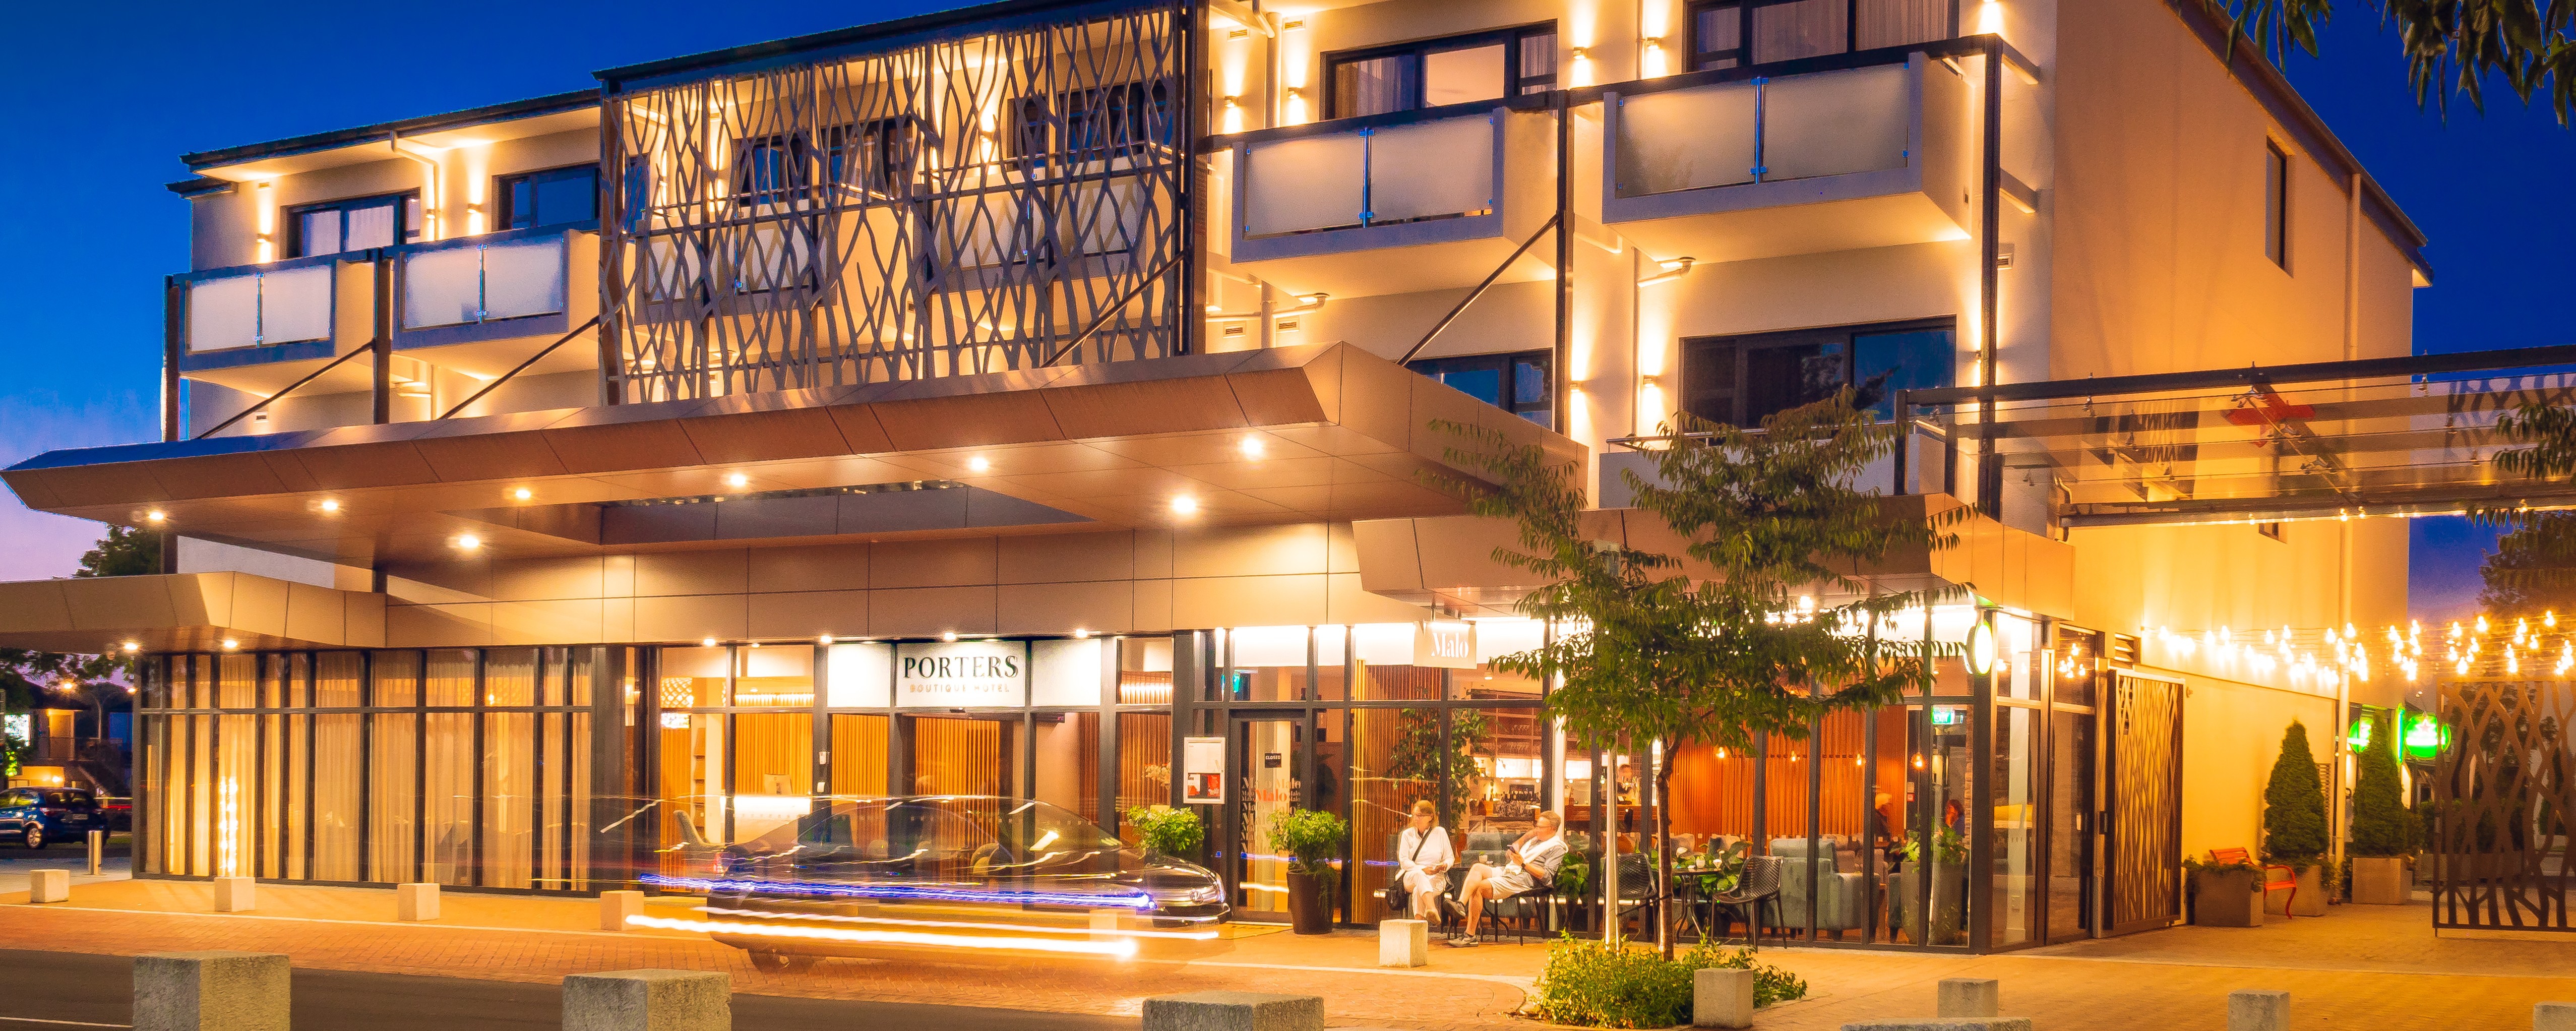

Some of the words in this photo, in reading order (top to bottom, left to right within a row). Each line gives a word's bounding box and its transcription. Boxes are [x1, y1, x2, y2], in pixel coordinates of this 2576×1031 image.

[1431, 632, 1469, 658] Malo
[904, 655, 1019, 679] PORTERS
[909, 684, 966, 693] BOUTIQUE
[974, 684, 1010, 693] HOTEL
[1254, 789, 1287, 802] Malo
